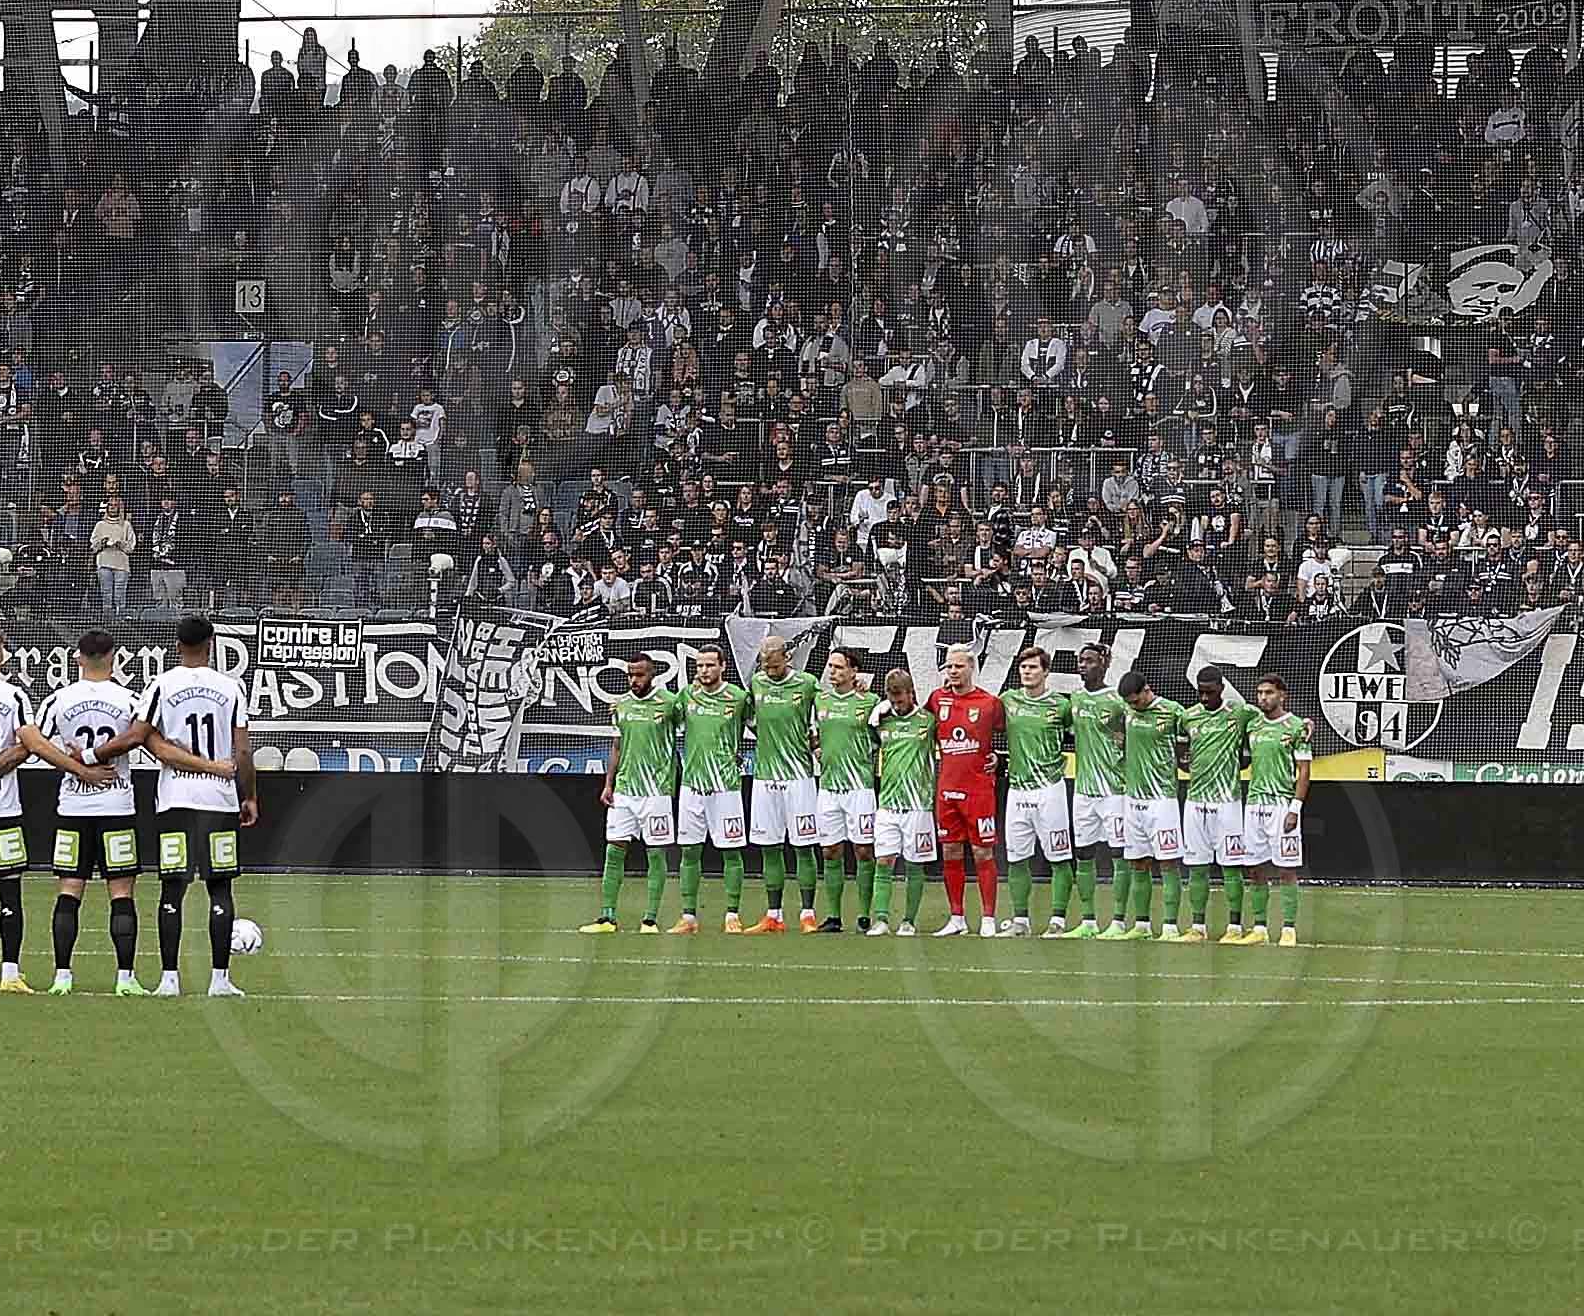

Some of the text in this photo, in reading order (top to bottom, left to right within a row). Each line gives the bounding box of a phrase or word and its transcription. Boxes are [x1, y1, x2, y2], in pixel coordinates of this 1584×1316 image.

[1496, 2, 1569, 37] 2009
[239, 285, 262, 308] 13
[264, 623, 357, 645] contre la
[263, 642, 356, 662] répression
[185, 713, 216, 761] 11
[1358, 709, 1404, 742] 94
[0, 833, 23, 863] E
[57, 834, 74, 864] E
[110, 836, 134, 864] E
[162, 840, 180, 866] E
[213, 838, 235, 864] E
